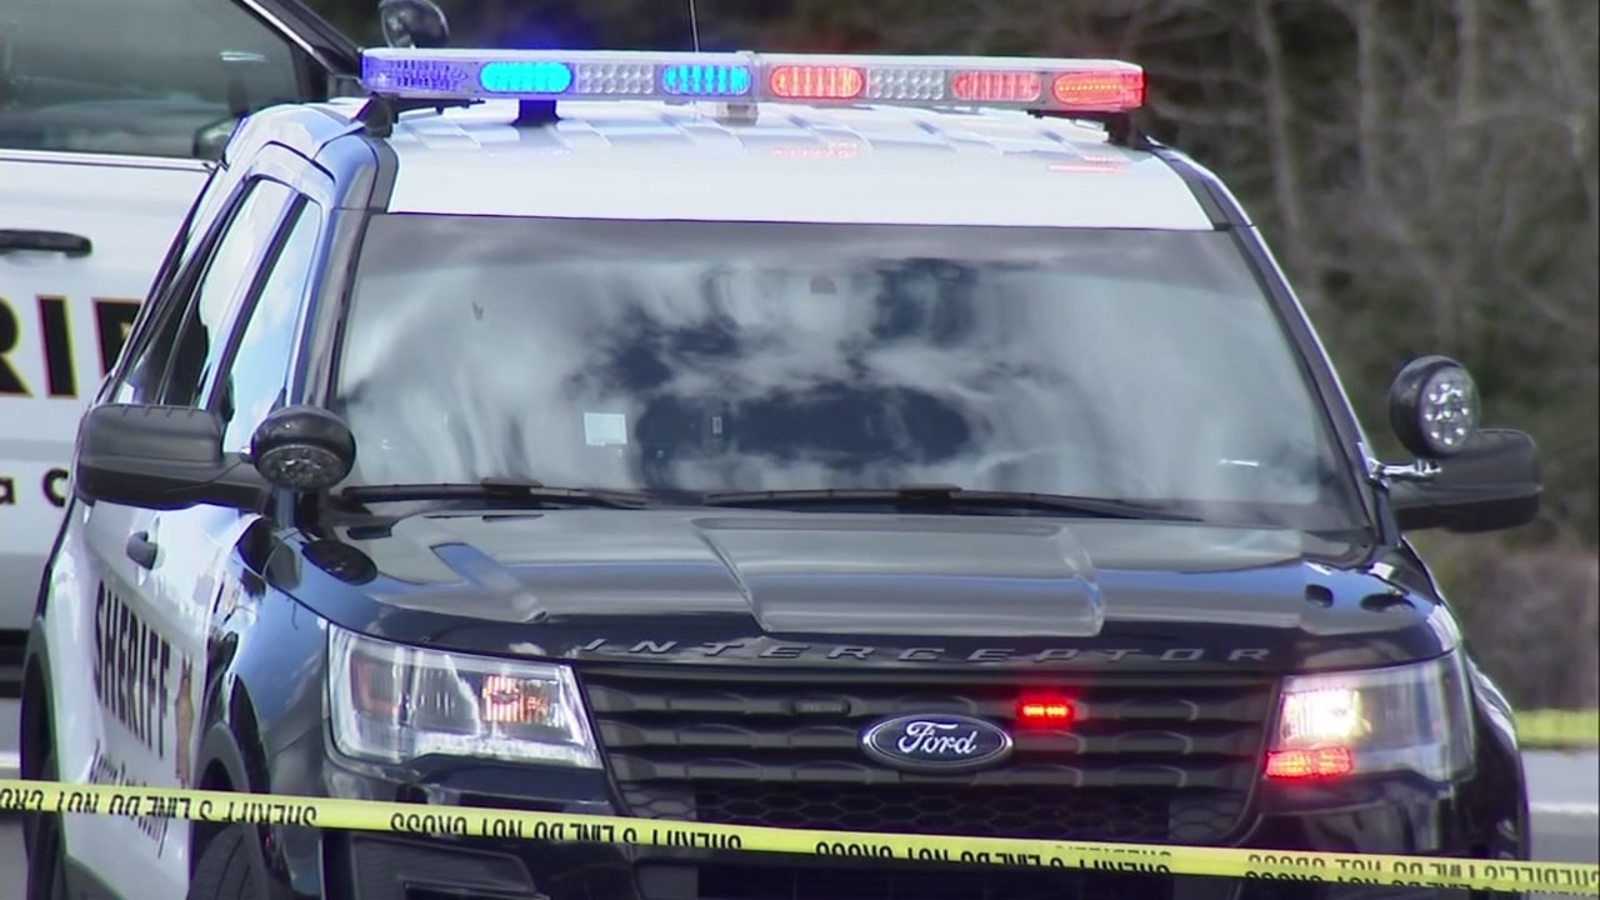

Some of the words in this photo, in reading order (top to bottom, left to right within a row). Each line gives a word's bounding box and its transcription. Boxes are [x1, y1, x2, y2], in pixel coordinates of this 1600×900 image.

[584, 638, 1271, 662] INTERCEPTOR
[94, 580, 170, 760] SHERIFF
[898, 721, 978, 755] Ford
[199, 800, 317, 827] SHERIFFS
